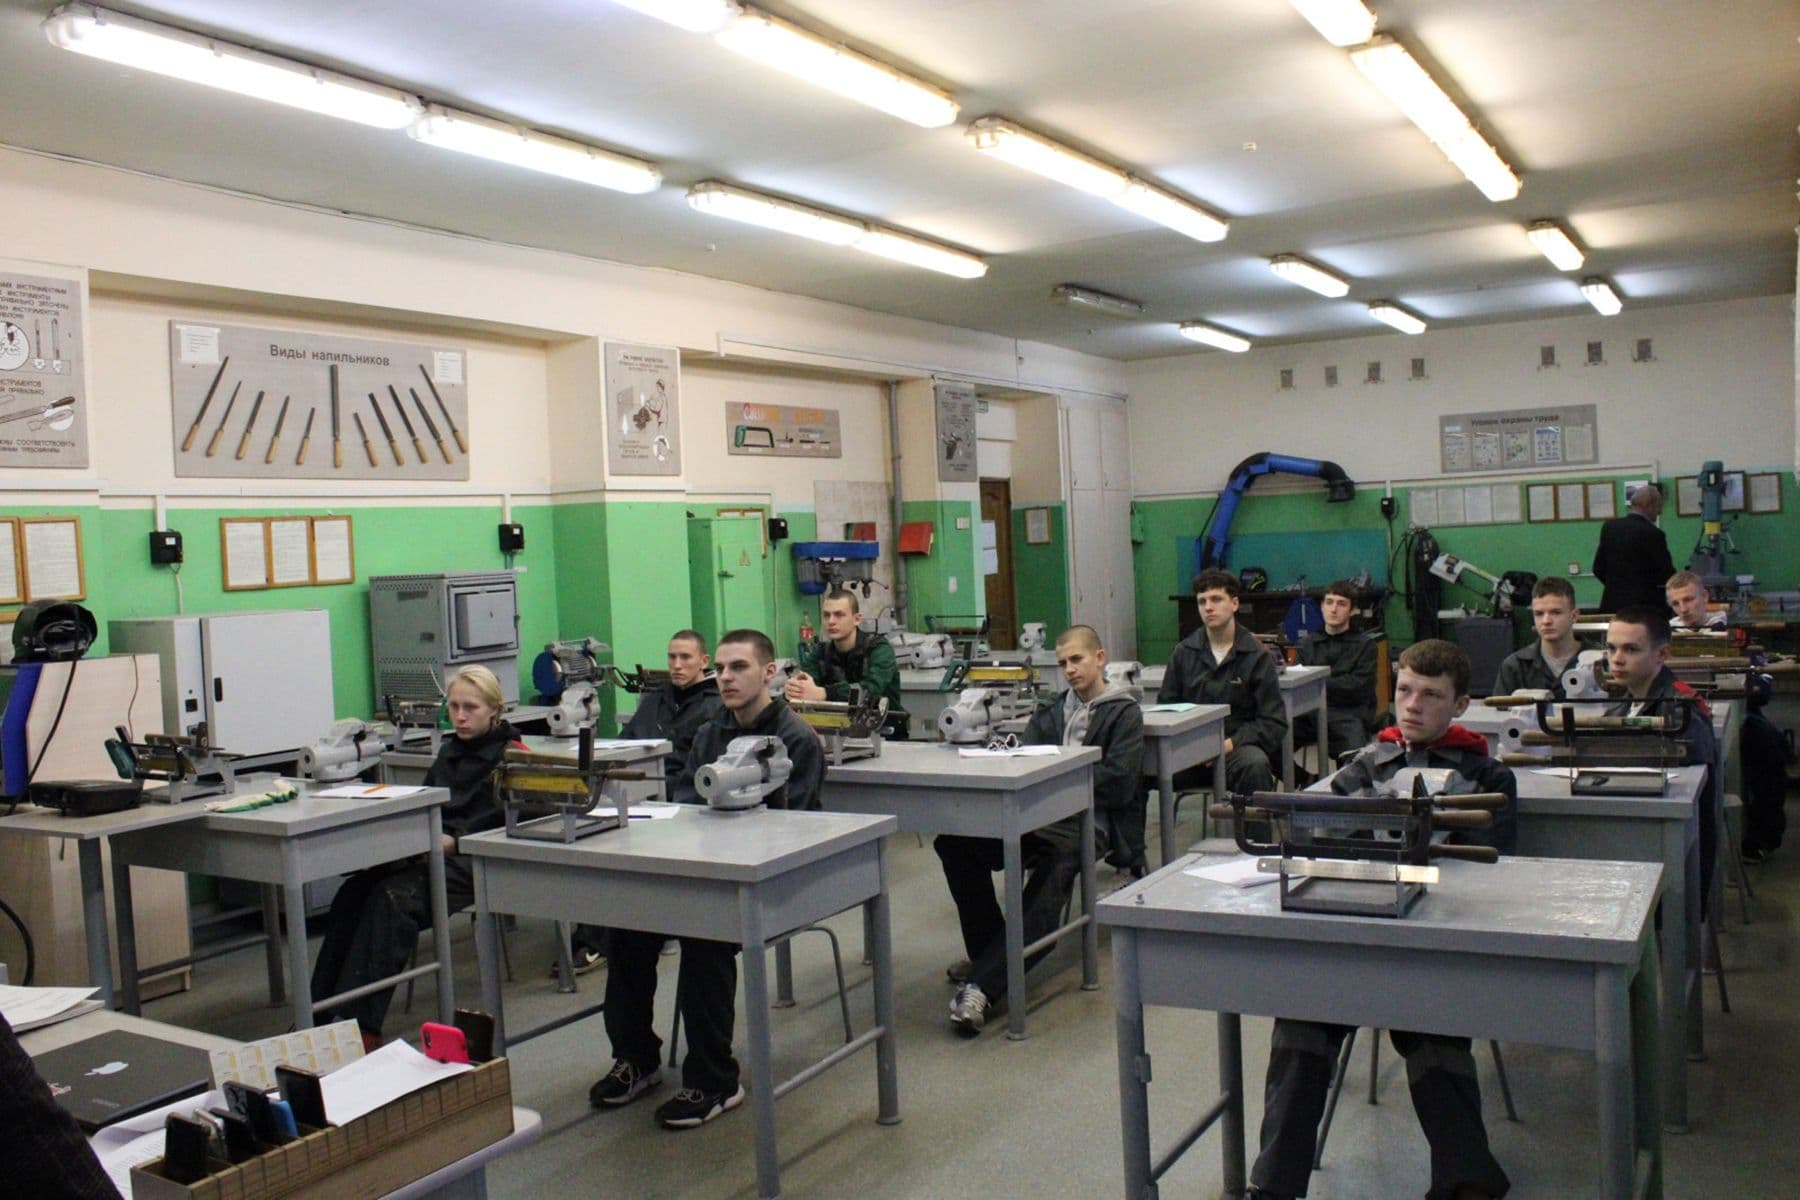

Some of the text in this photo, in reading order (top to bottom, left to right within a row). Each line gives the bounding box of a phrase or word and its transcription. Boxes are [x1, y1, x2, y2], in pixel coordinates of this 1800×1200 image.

[270, 344, 390, 366] Виды напильников
[1501, 415, 1533, 424] охраны
[1535, 414, 1560, 424] труда
